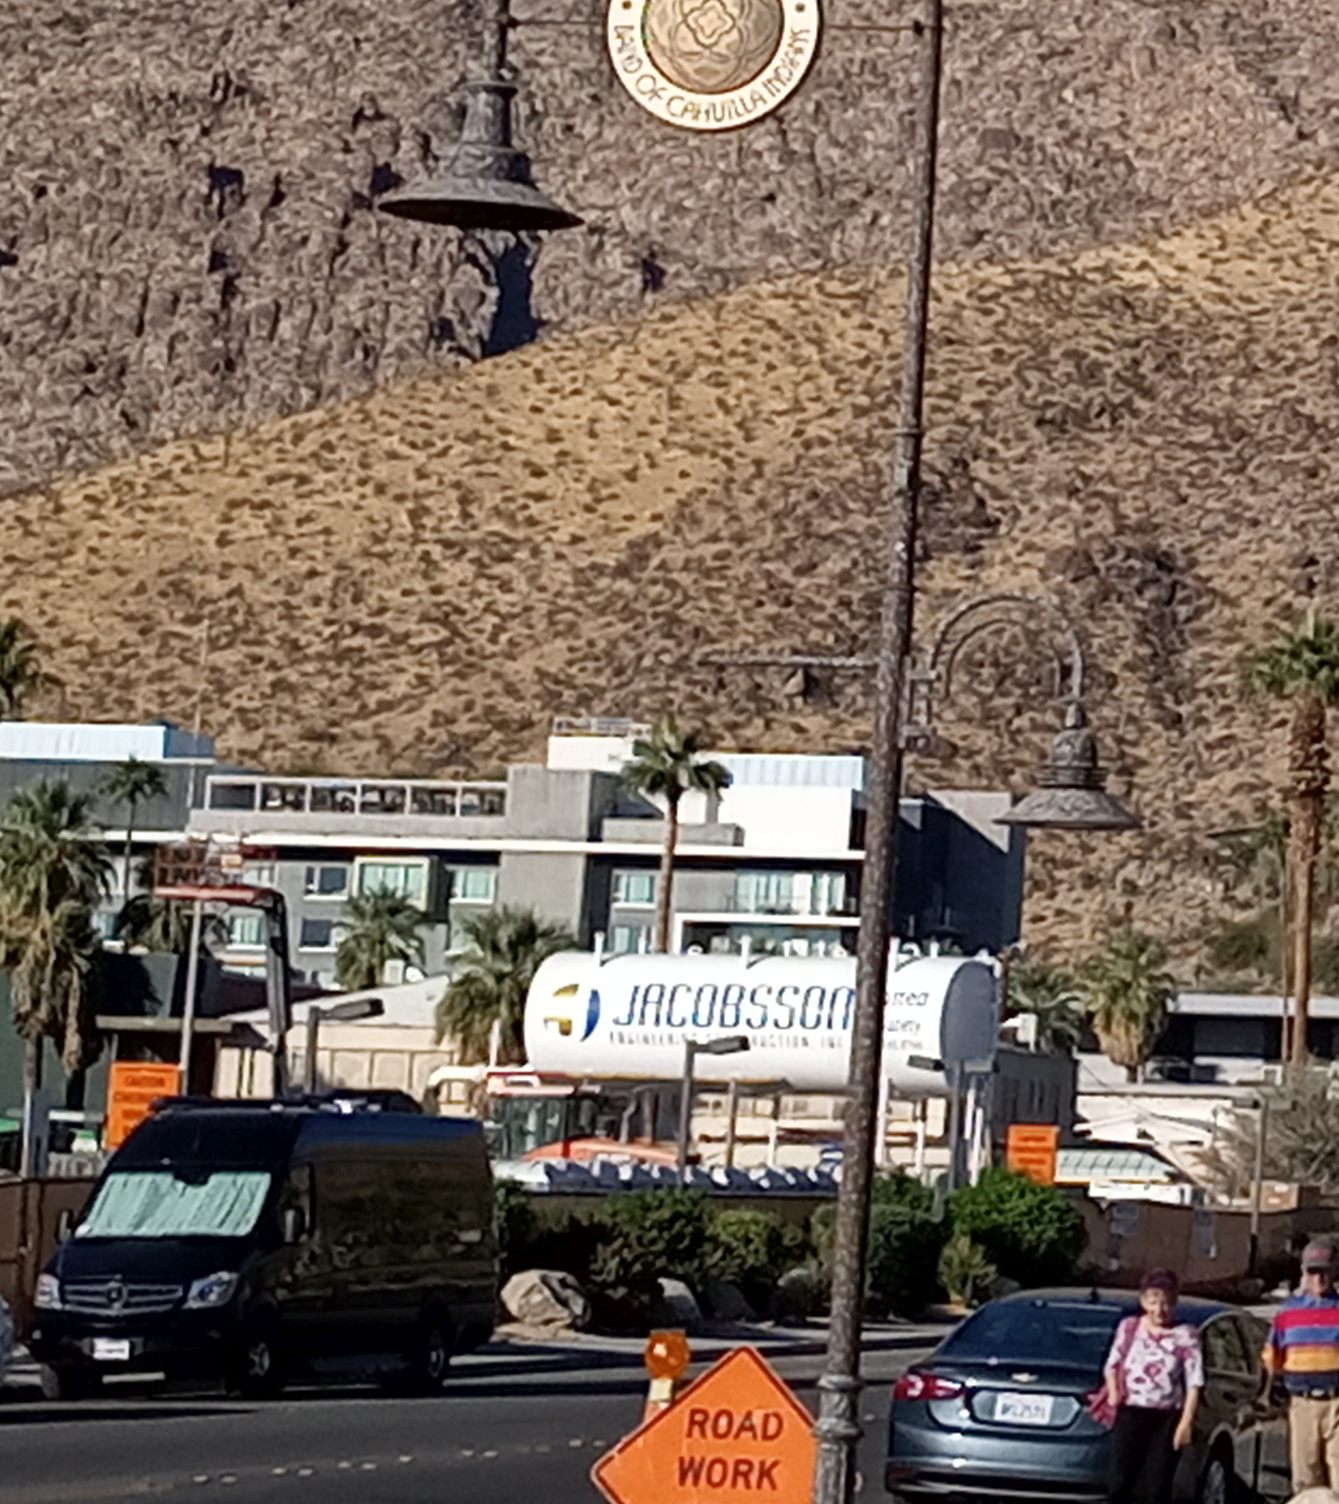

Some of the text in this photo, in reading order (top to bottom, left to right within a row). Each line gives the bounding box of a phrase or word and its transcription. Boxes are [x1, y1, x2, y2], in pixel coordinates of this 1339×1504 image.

[635, 74, 667, 101] OF
[611, 983, 857, 1030] JACOBSSON
[685, 1407, 784, 1442] ROAD
[677, 1455, 782, 1491] WORK
